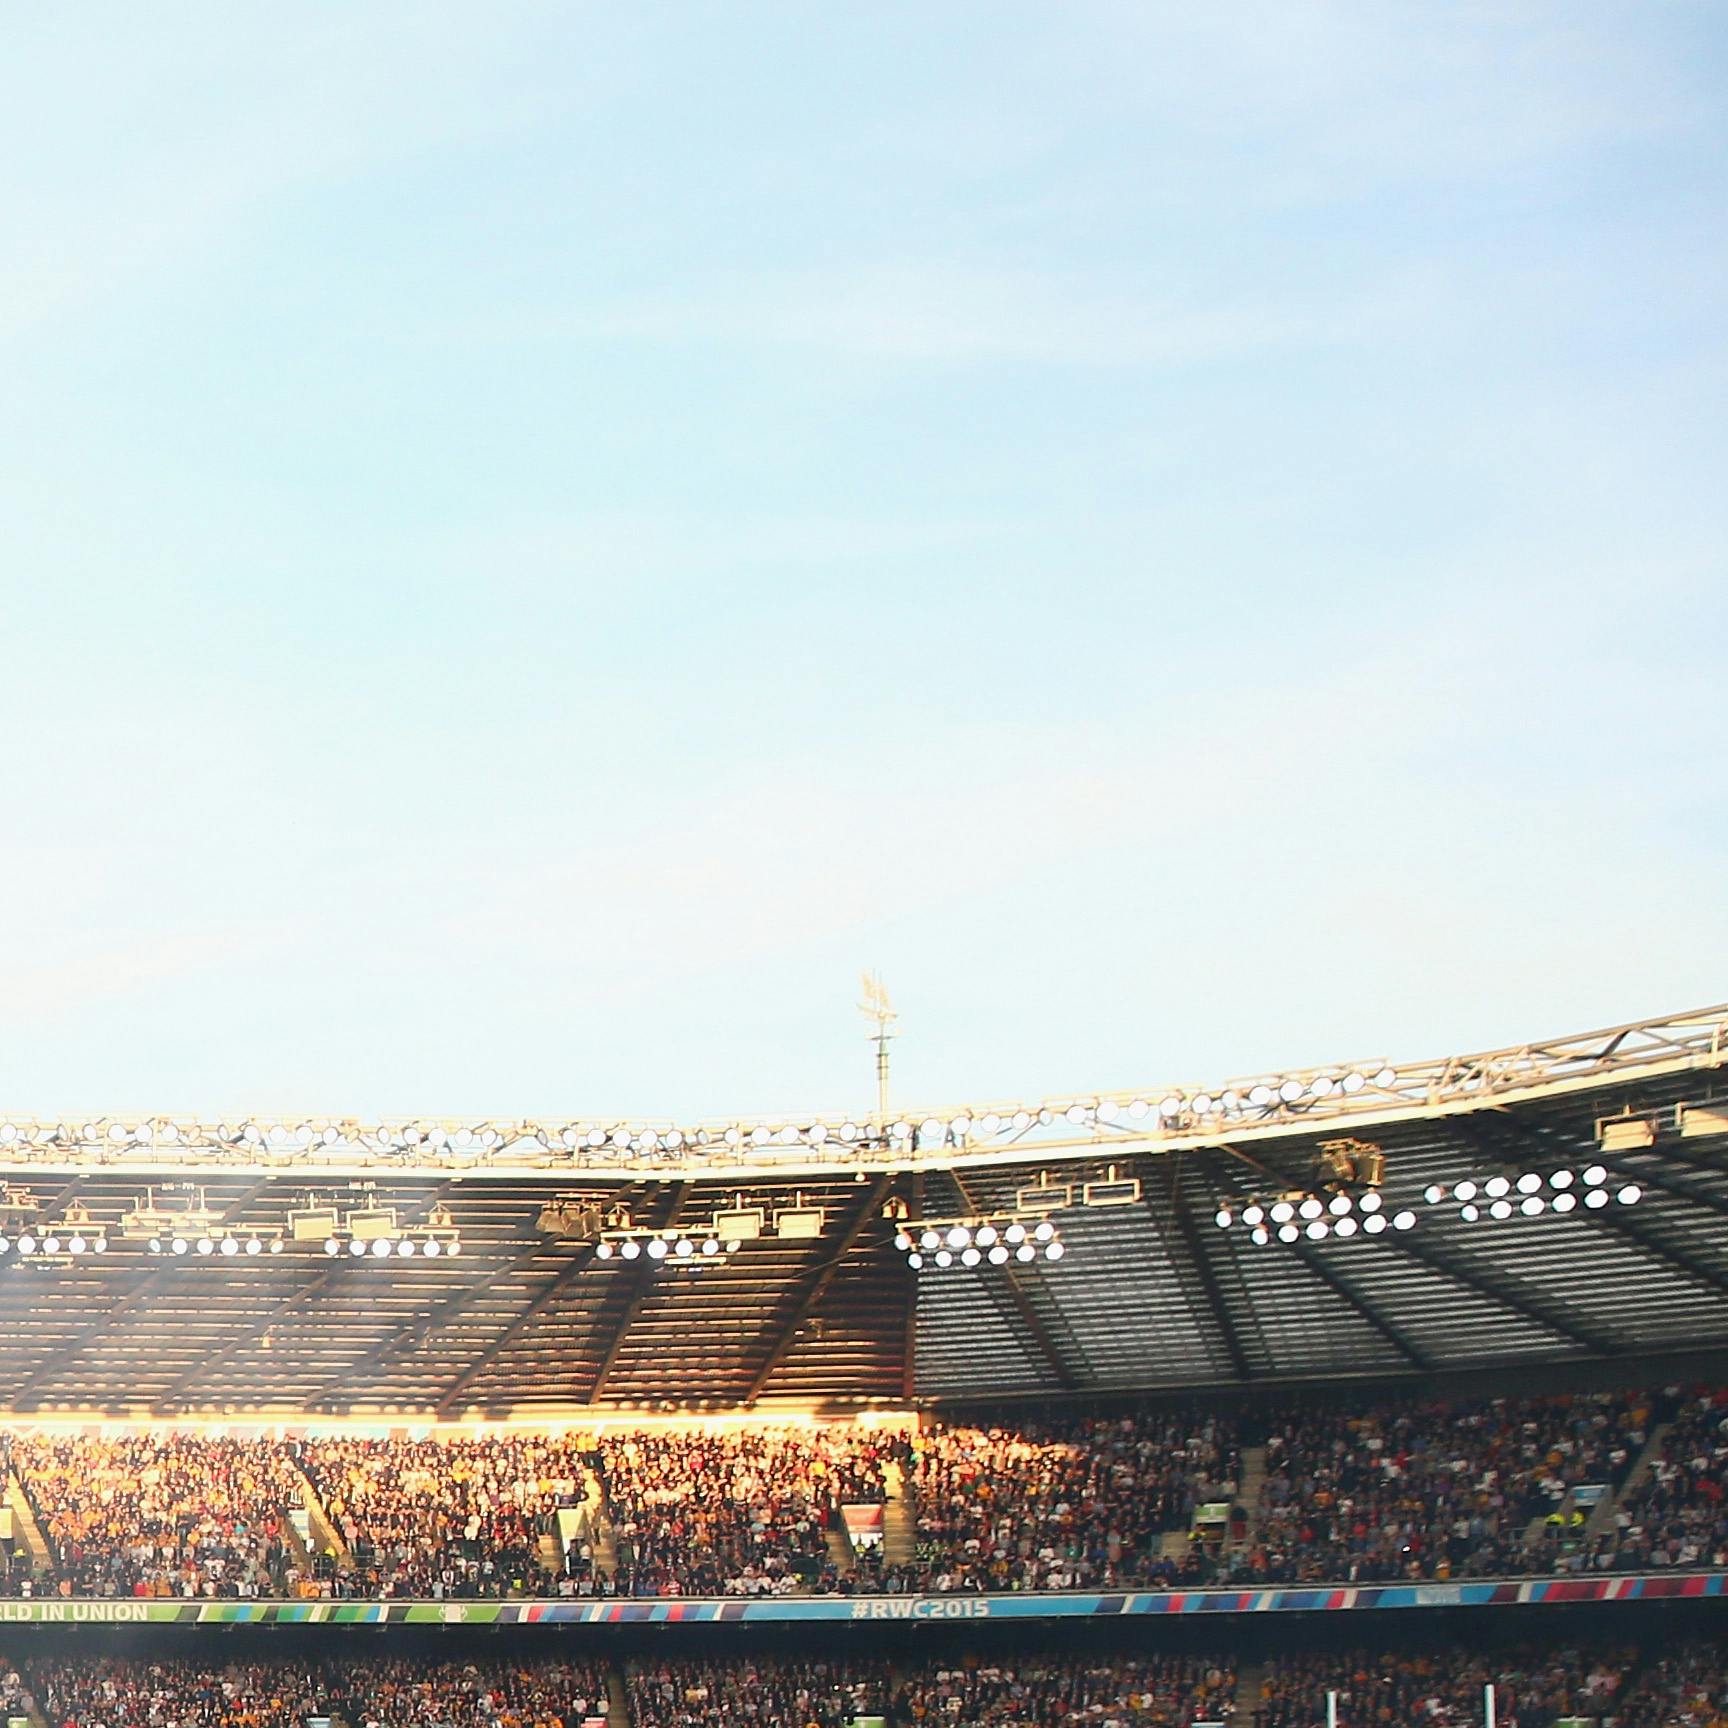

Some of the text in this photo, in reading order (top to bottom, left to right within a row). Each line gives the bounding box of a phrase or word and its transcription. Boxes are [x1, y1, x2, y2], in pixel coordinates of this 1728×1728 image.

[41, 1604, 66, 1621] IN
[72, 1604, 149, 1621] UNION
[850, 1600, 990, 1619] #RWC2015
